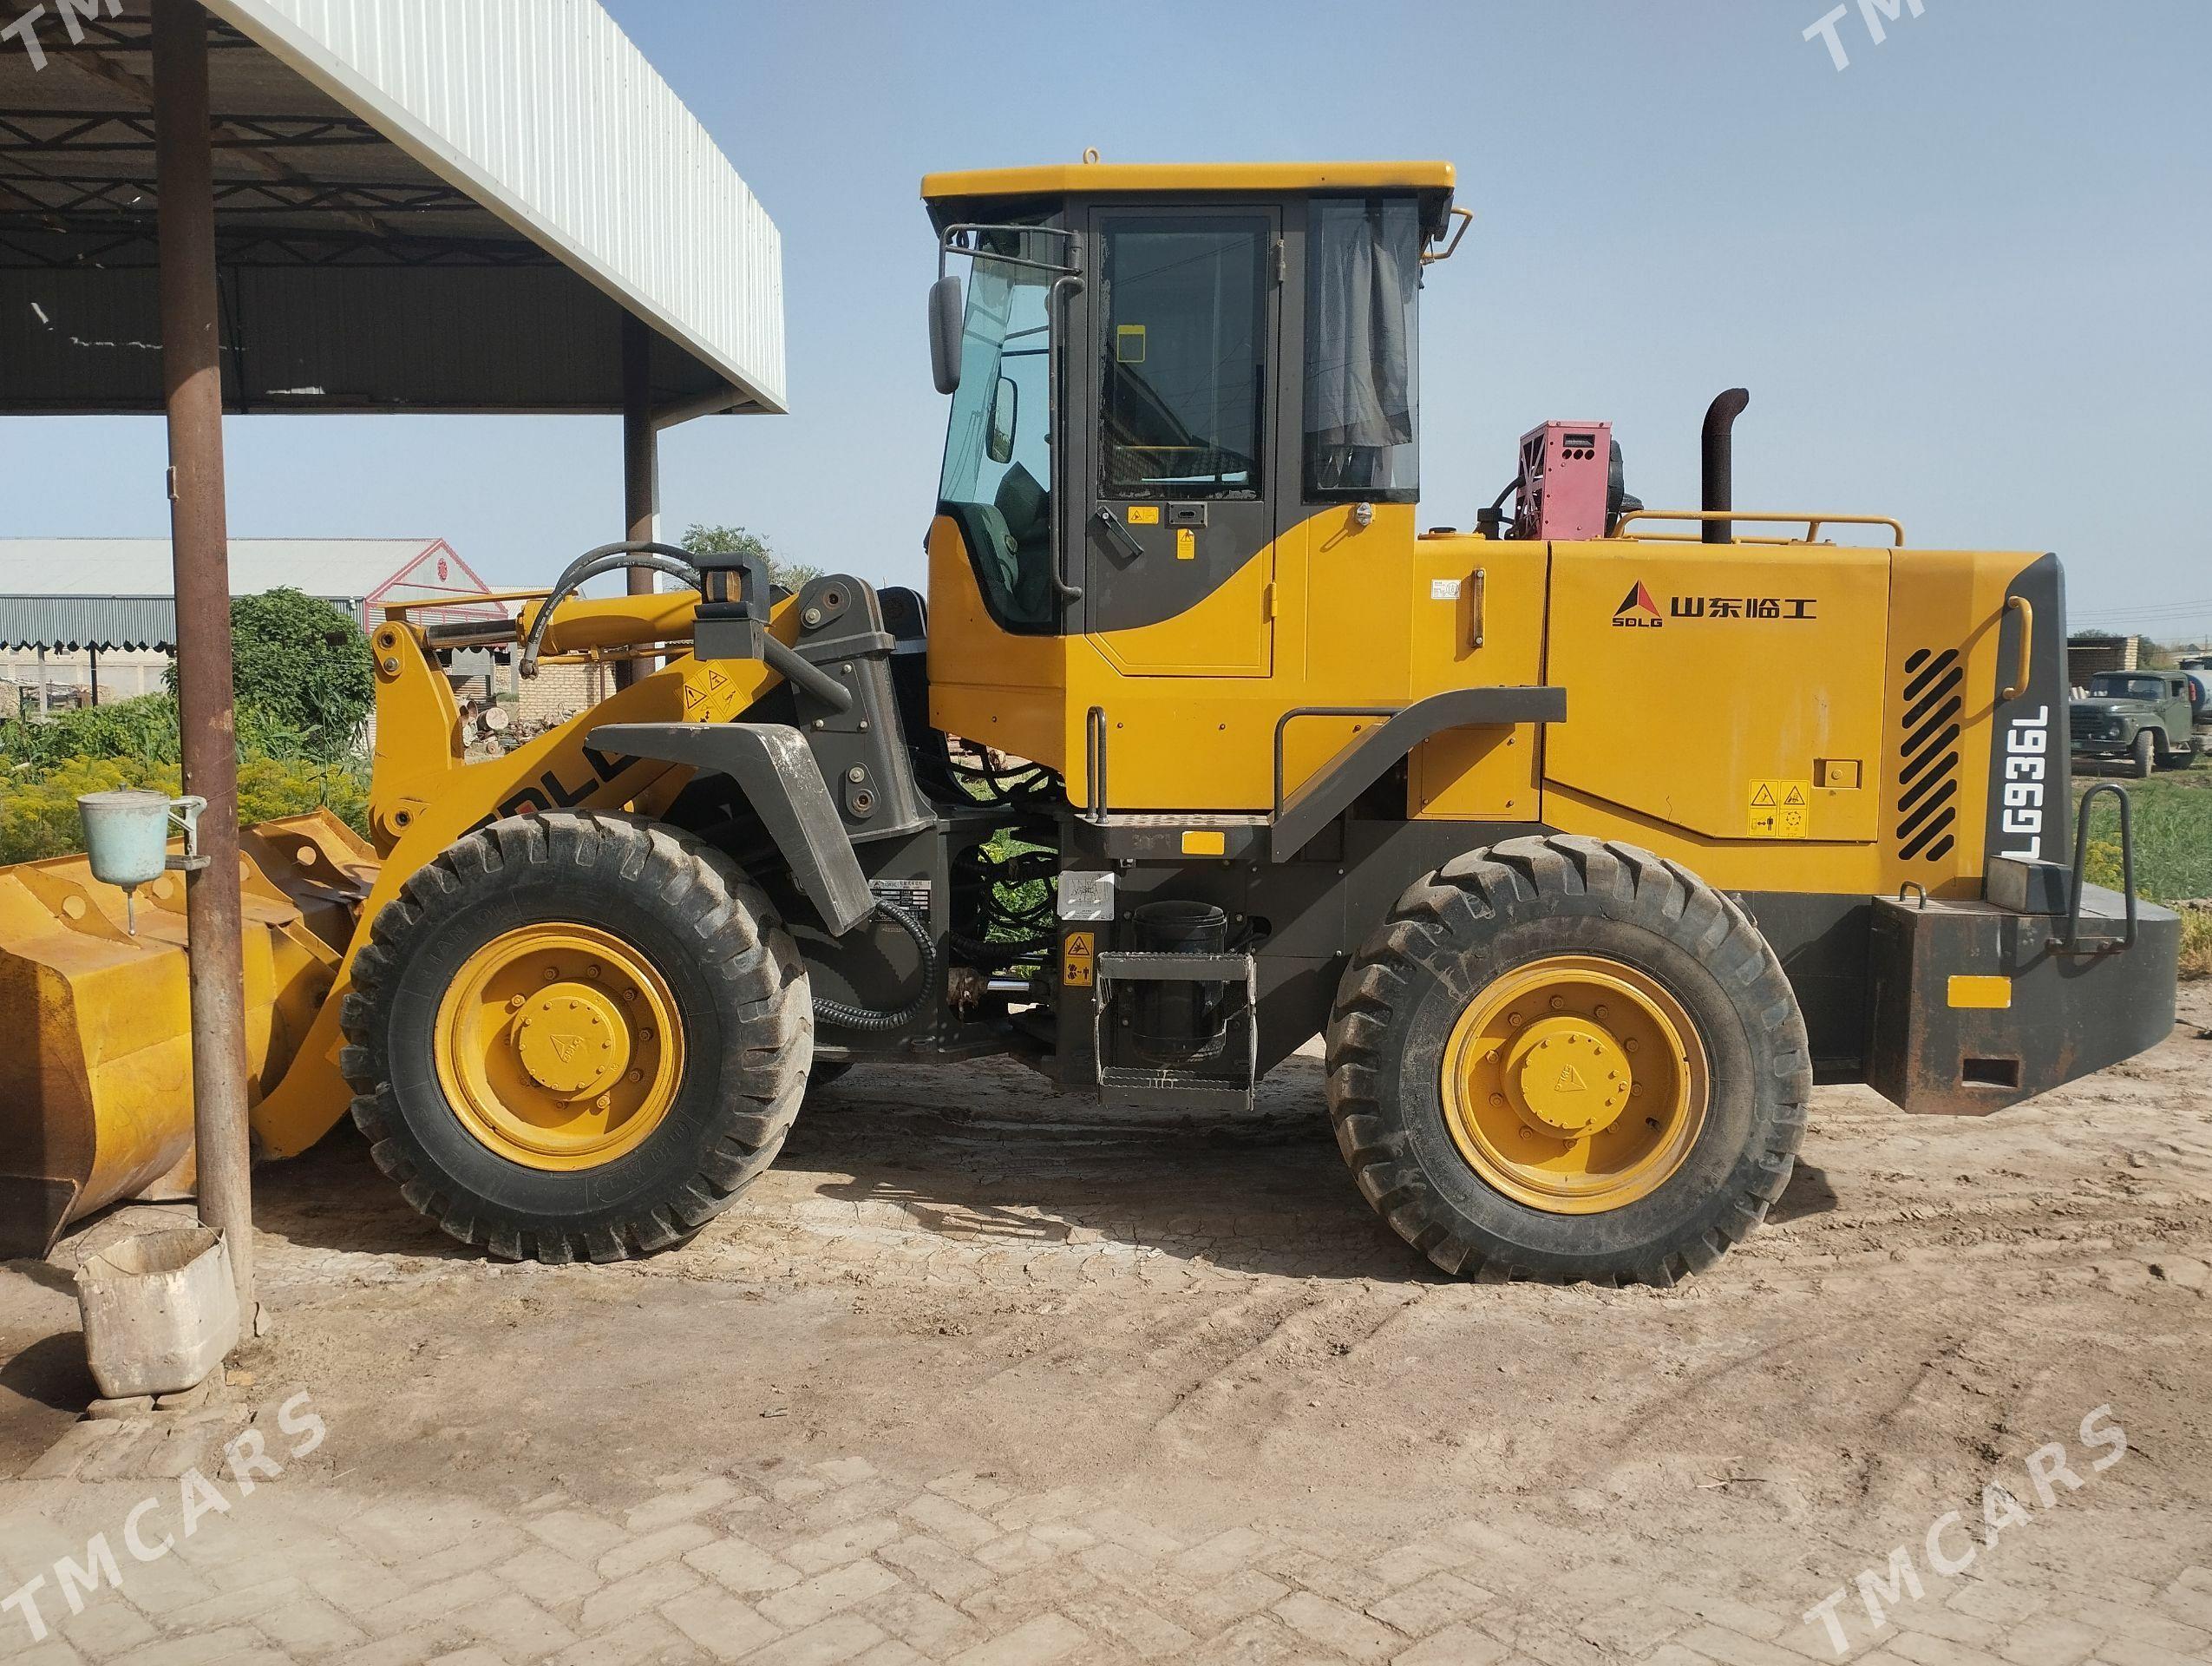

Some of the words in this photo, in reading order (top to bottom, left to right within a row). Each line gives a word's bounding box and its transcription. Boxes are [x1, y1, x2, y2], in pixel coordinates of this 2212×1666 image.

[1671, 596, 1817, 620] 山东临工
[1612, 618, 1663, 627] SDLG
[2001, 705, 2049, 859] LG936L
